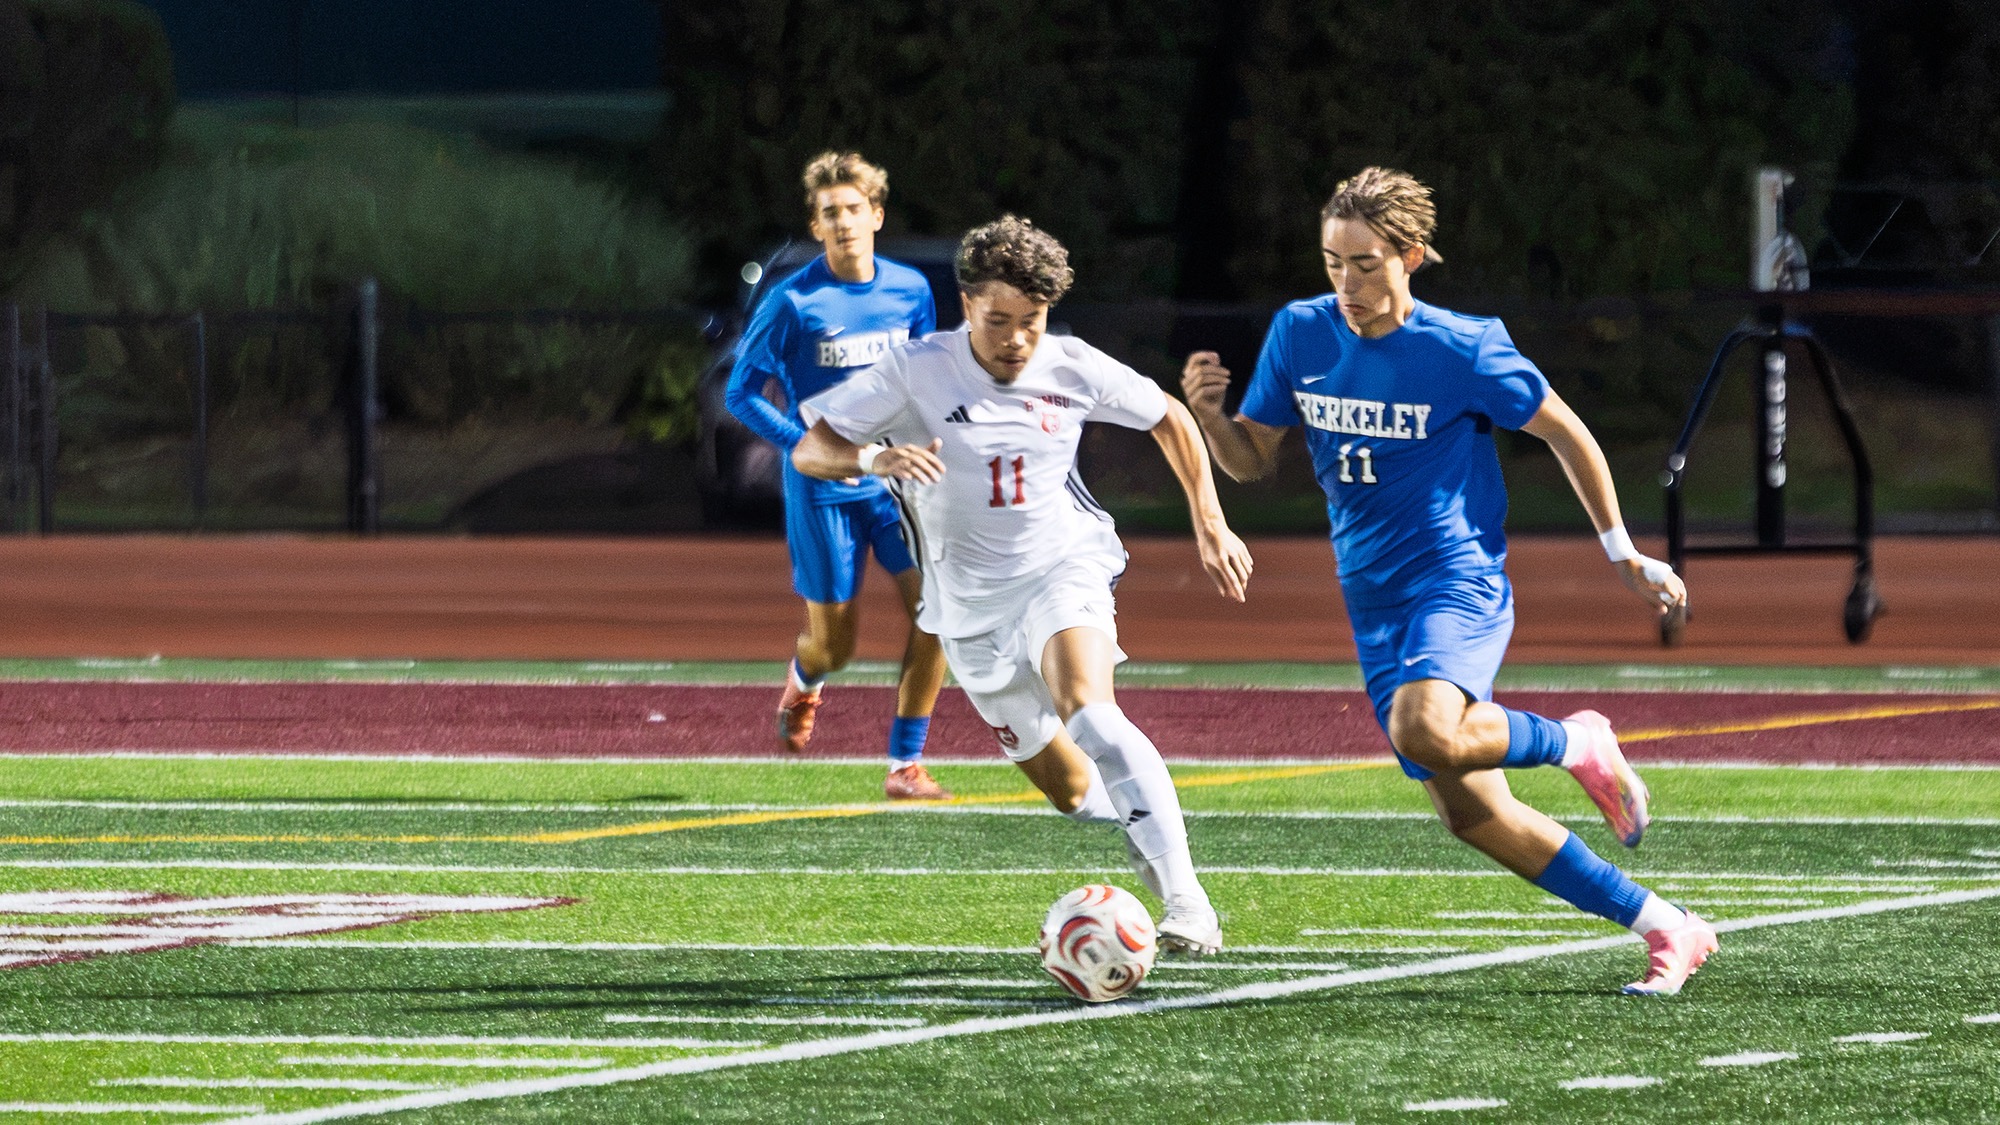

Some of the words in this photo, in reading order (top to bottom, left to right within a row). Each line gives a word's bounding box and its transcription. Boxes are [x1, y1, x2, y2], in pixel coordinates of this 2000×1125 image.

[1294, 391, 1432, 440] BERKELEY
[988, 455, 1026, 508] 11
[1338, 443, 1378, 484] 11
